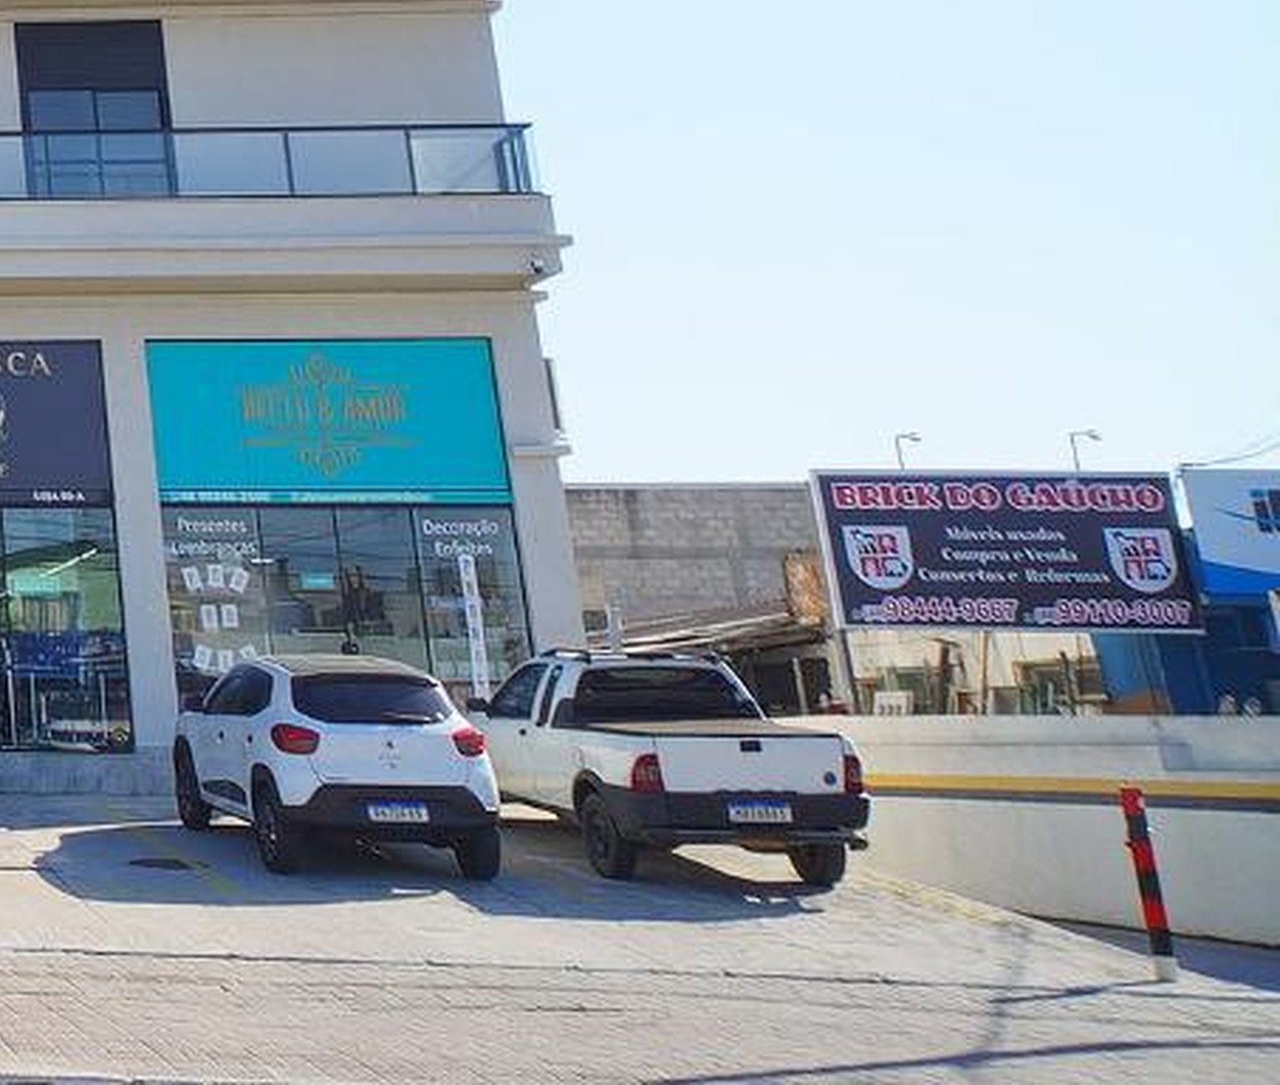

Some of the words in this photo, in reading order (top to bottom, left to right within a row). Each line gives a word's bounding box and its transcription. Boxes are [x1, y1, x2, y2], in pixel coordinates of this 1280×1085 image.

[831, 482, 941, 510] BRICK
[944, 484, 1001, 511] DO
[176, 517, 248, 533] Presentes
[423, 518, 499, 537] Decoração
[1007, 526, 1065, 542] usados
[941, 547, 1010, 564] Compra
[1026, 547, 1079, 563] Venda
[917, 568, 1006, 584] Consertos
[1025, 569, 1113, 585] Reformas
